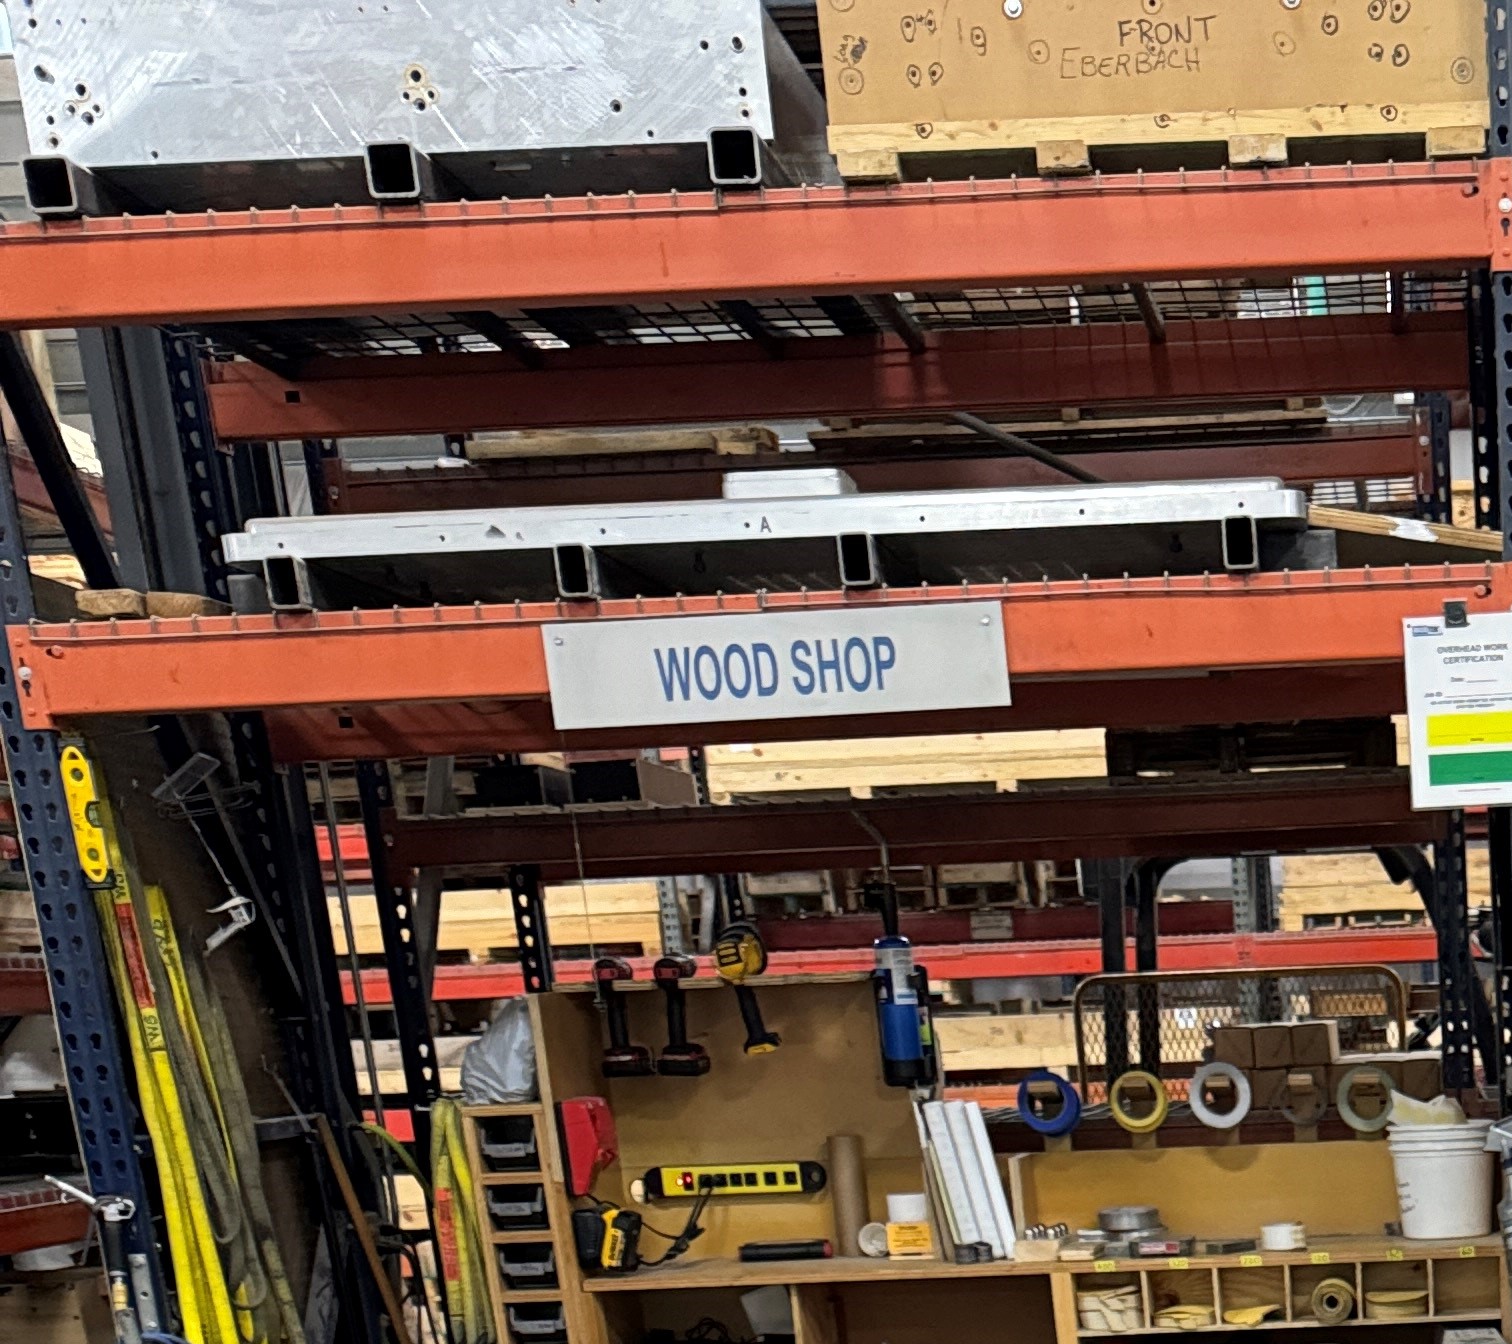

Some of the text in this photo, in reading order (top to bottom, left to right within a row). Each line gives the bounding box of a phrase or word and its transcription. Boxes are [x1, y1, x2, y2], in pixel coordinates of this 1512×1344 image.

[1117, 15, 1217, 47] FRONT
[1060, 46, 1200, 79] EBERBACH
[759, 515, 772, 533] A
[653, 636, 896, 702] WOOD SHOP
